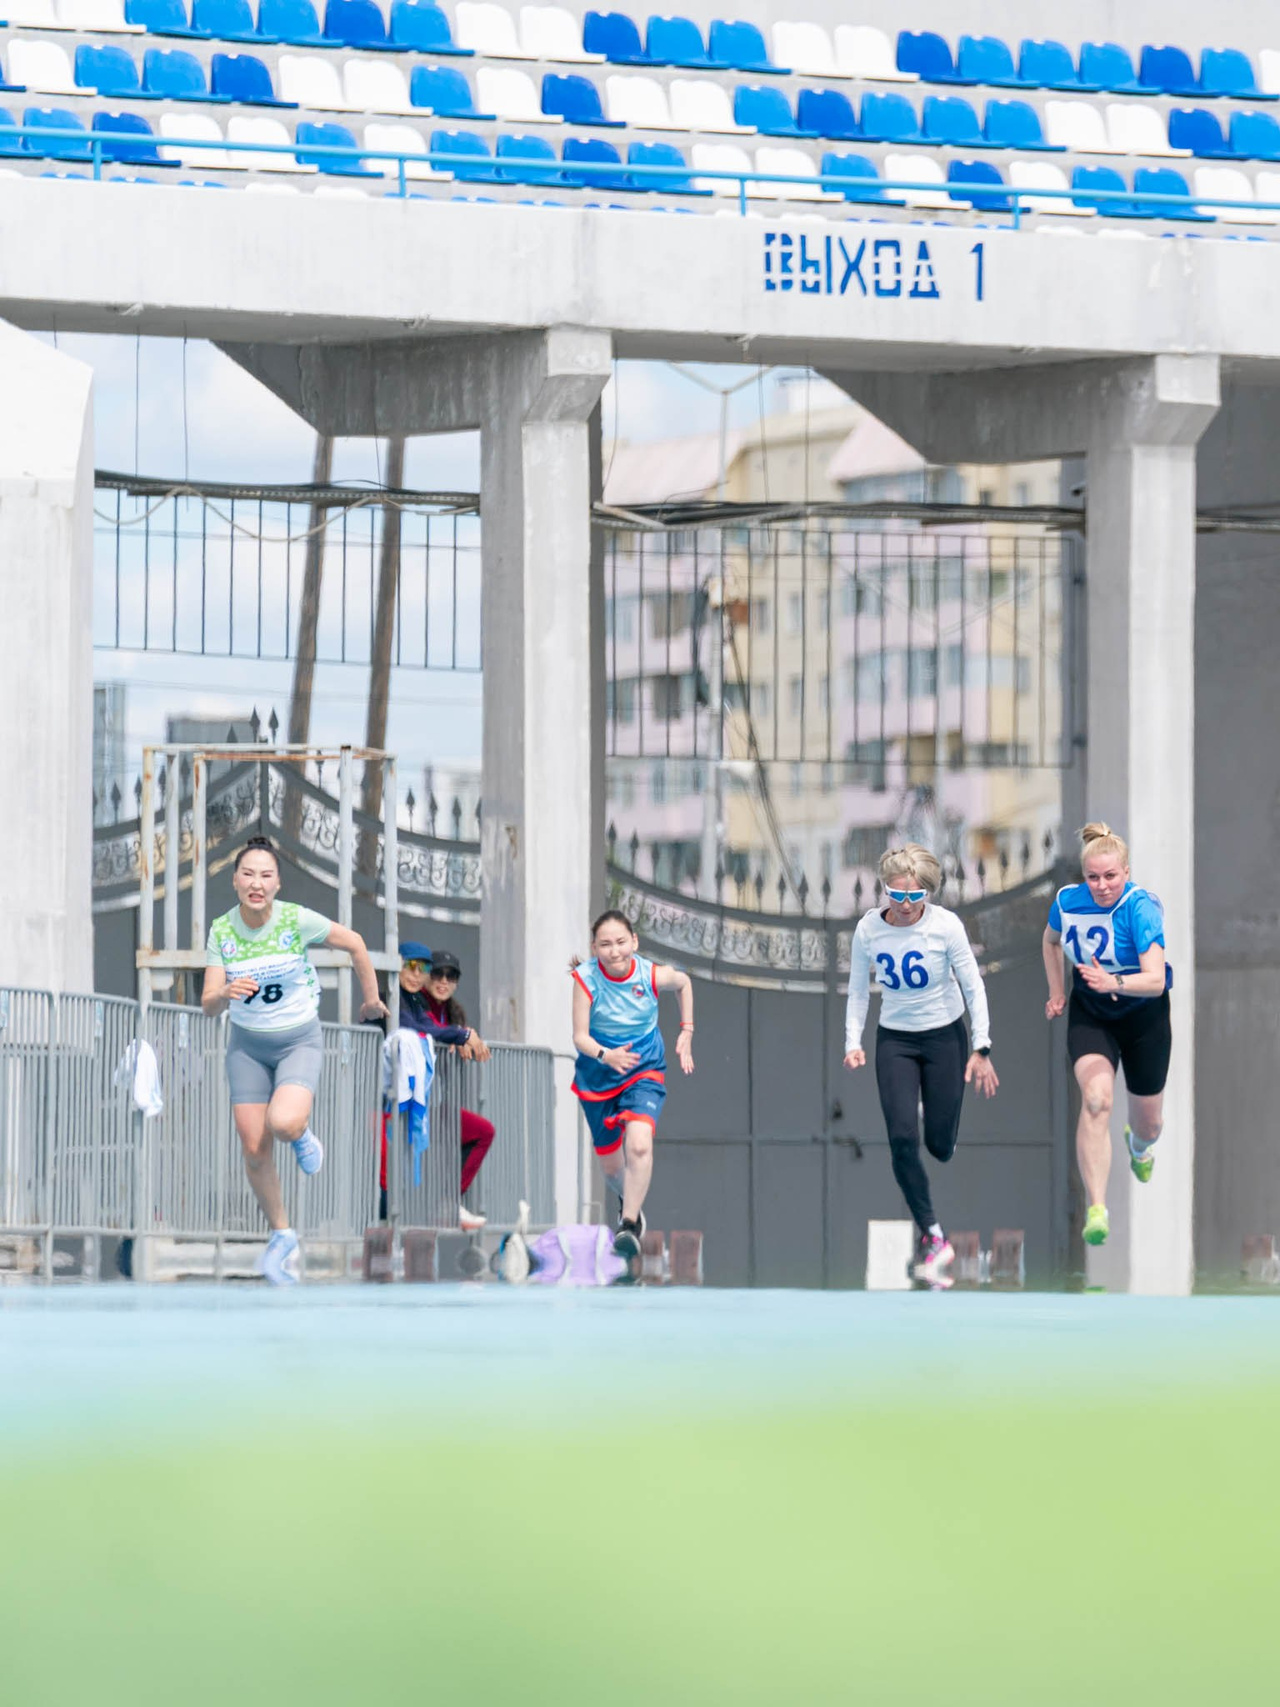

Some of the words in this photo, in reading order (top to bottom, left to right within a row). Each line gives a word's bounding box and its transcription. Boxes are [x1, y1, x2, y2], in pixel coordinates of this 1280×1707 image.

[764, 232, 940, 299] ВЫХОД
[970, 242, 984, 302] 1
[1065, 924, 1115, 966] 12
[876, 950, 929, 990] 36
